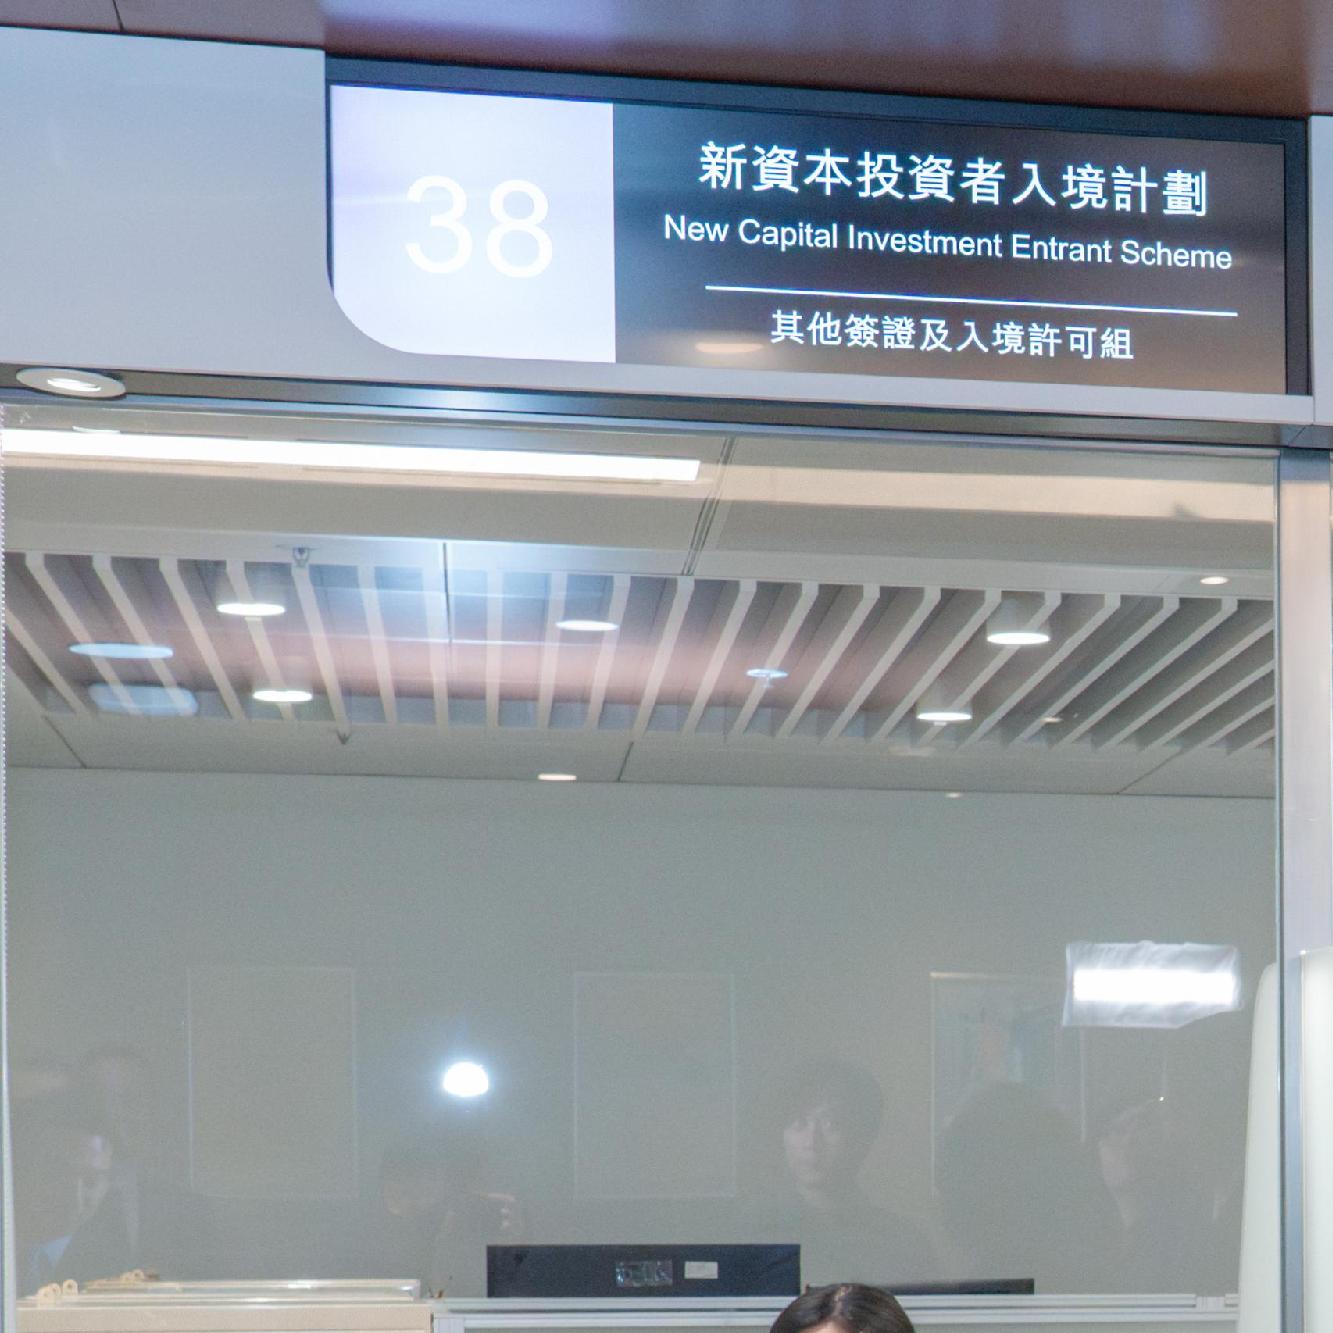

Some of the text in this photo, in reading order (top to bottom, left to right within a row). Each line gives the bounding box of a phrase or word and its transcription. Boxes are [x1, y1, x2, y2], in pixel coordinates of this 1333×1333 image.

[698, 141, 1206, 216] 新資本投資者入境計劃
[406, 175, 552, 280] 38
[665, 214, 1232, 269] New Capital Investment Entrant Scheme
[770, 310, 1135, 361] 其他簽證及入境許可組
